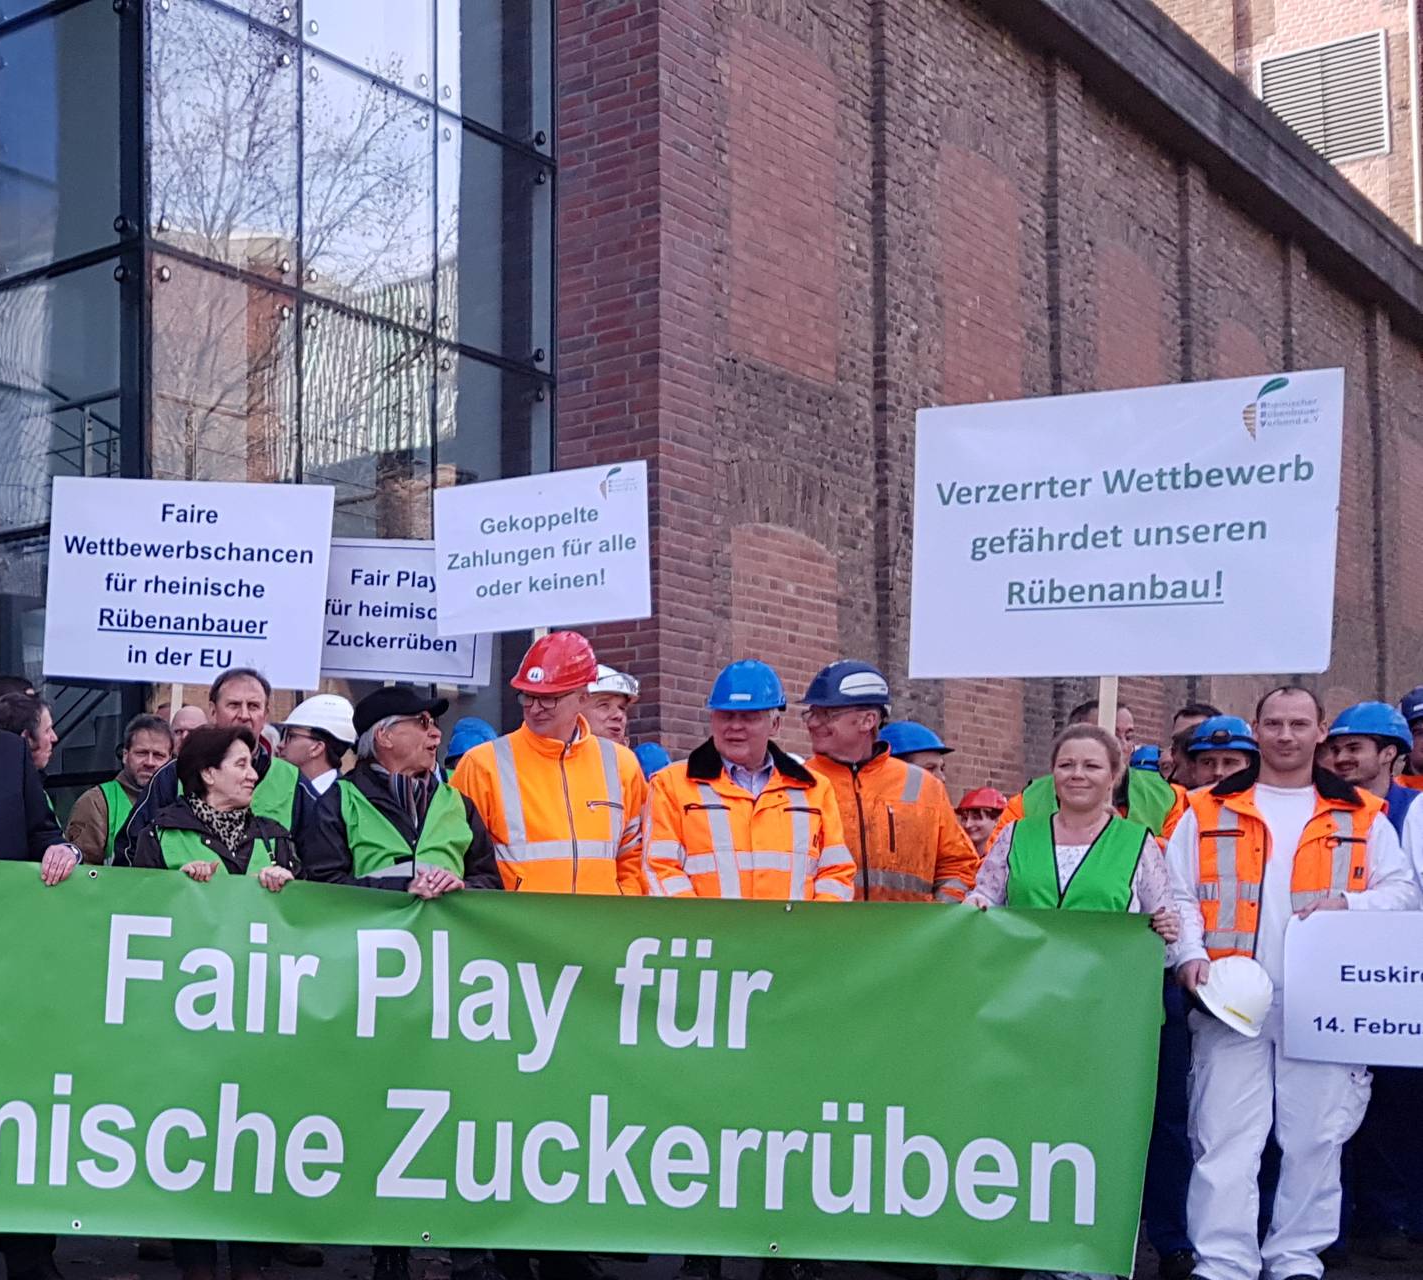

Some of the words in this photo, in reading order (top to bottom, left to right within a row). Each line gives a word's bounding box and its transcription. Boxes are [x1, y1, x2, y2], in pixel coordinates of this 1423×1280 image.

[937, 474, 1092, 506] Verzerrter
[1102, 454, 1314, 495] Wettbewerb
[161, 503, 218, 524] Faire
[480, 507, 598, 535] Gekoppelte
[64, 535, 313, 564] Wettbewerbschancen
[447, 545, 555, 571] Zahlungen
[562, 538, 592, 559] für
[598, 535, 637, 552] alle
[970, 524, 1122, 561] gefährdet
[1133, 519, 1267, 547] unseren
[105, 573, 137, 592] für
[144, 575, 265, 598] rheinische
[351, 569, 390, 586] Fair
[476, 580, 522, 598] oder
[529, 568, 606, 593] keinen!
[1007, 571, 1223, 605] Rübenanbau!
[99, 608, 268, 634] Rübenanbauer
[325, 599, 352, 616] für
[326, 630, 457, 652] Zuckerrüben
[128, 645, 147, 664] in
[155, 647, 192, 667] der
[200, 649, 232, 668] EU
[1340, 965, 1423, 983] Euskir
[104, 913, 320, 1035] Fair
[356, 929, 582, 1073] Play
[616, 936, 774, 1050] für
[1313, 1016, 1345, 1033] 14.
[376, 1088, 1096, 1226] Zuckerrüben
